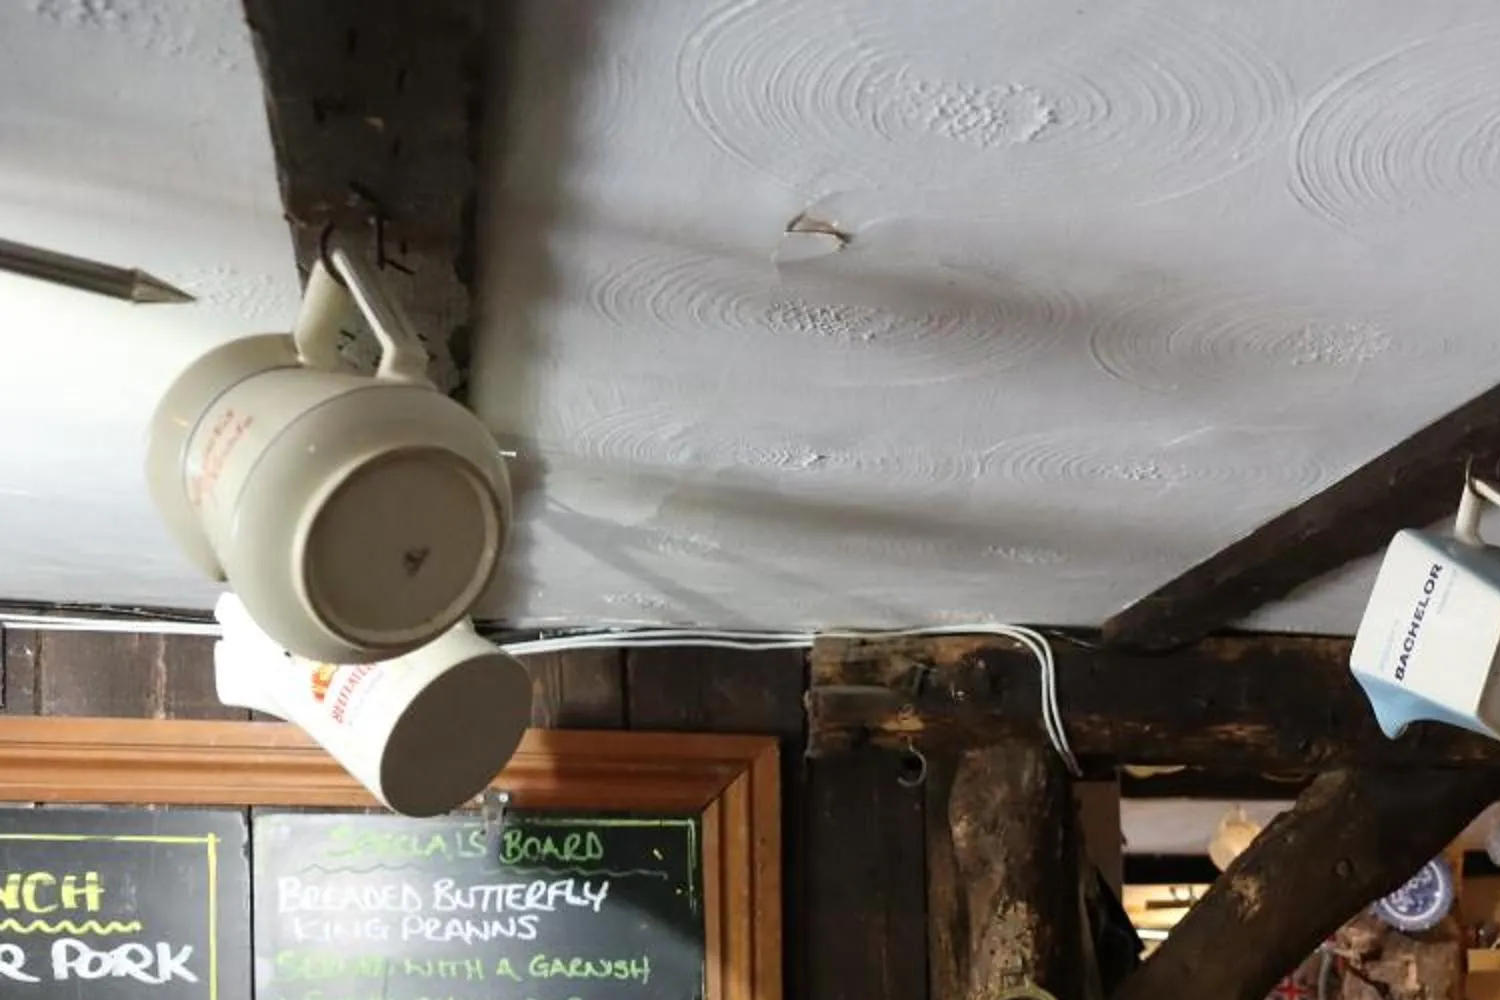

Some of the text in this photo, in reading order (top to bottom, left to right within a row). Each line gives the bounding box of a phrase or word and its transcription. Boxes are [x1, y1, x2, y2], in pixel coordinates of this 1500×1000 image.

[1394, 563, 1444, 681] BACHELOR
[500, 829, 605, 861] BOARD
[278, 876, 609, 914] BREADED BUTTERFLY
[293, 915, 541, 944] KING PRAWNS
[51, 938, 200, 985] PORK
[404, 957, 485, 982] WITH
[496, 959, 523, 982] A
[528, 954, 651, 985] GARNISH
